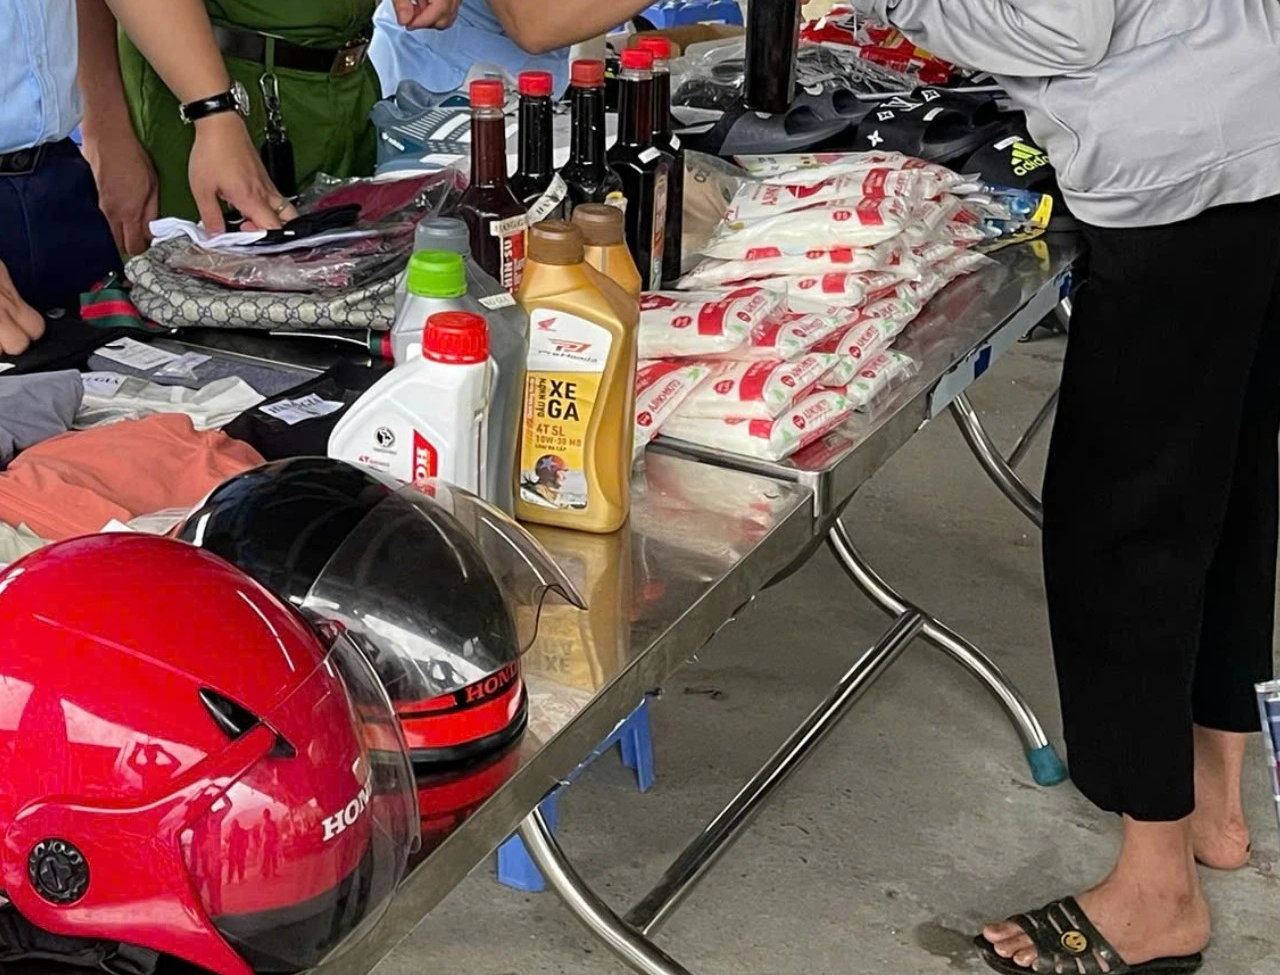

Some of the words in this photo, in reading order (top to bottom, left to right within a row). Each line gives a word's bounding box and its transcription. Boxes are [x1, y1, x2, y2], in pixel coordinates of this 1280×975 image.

[549, 379, 577, 401] XE
[547, 399, 580, 422] GA
[536, 424, 551, 435] 4T
[551, 426, 565, 437] SL
